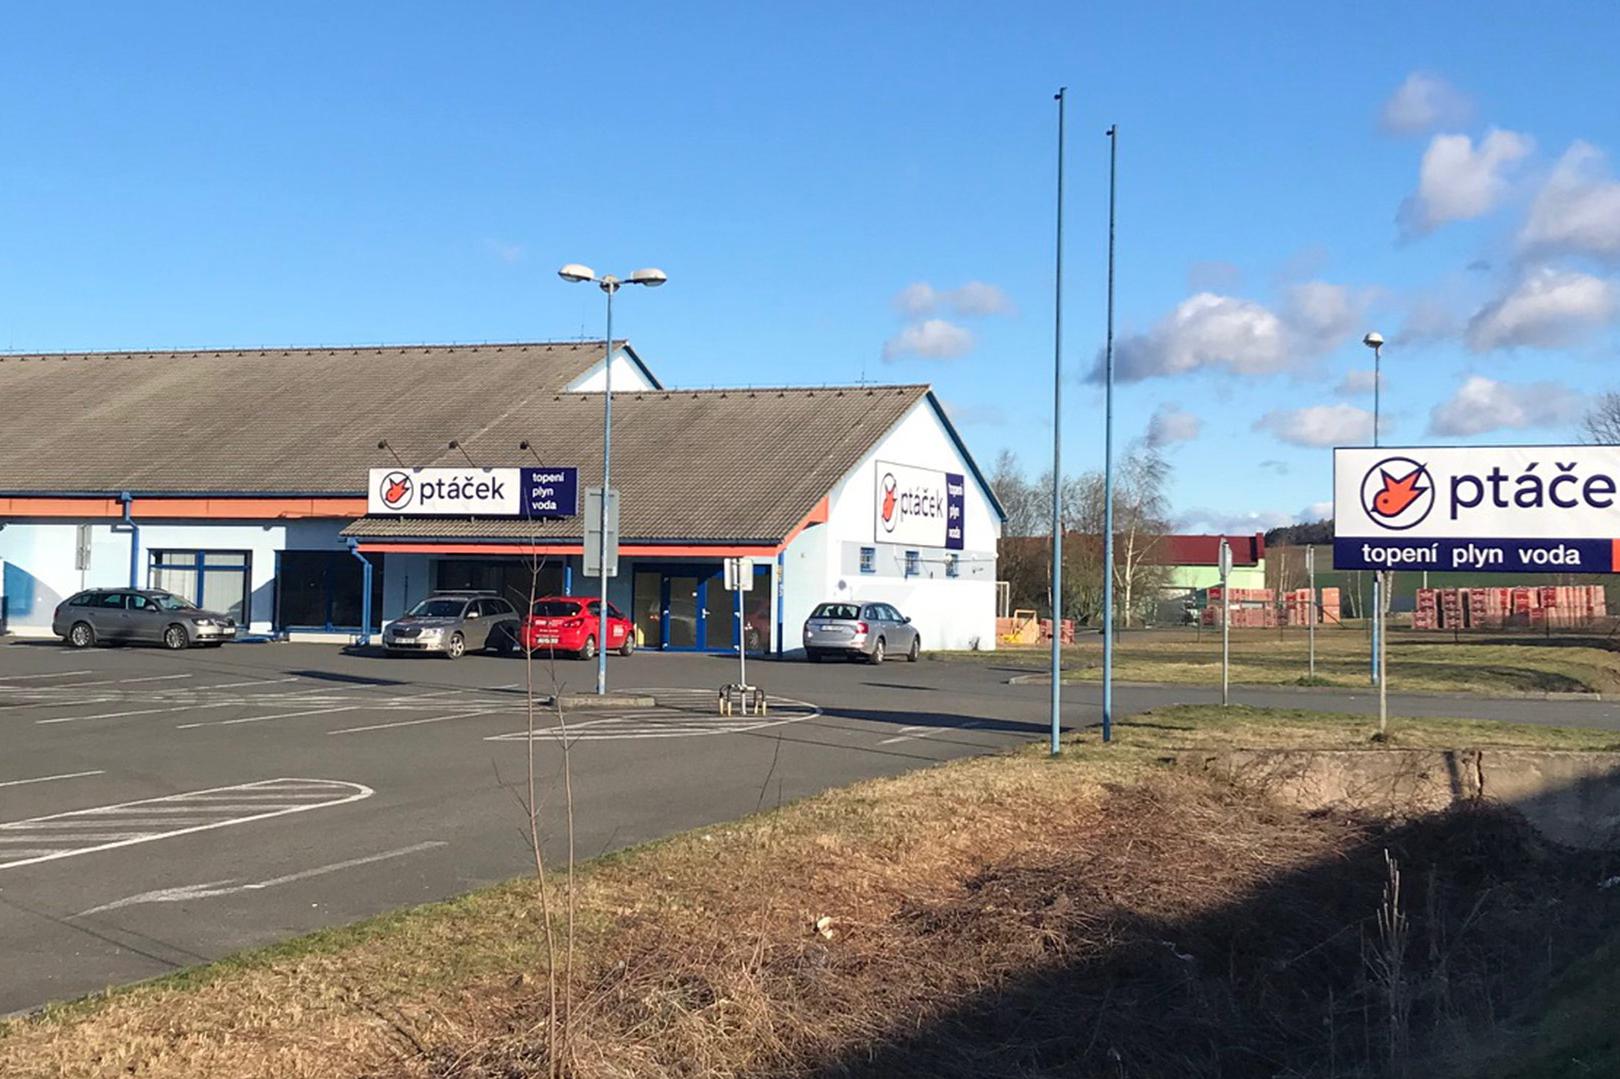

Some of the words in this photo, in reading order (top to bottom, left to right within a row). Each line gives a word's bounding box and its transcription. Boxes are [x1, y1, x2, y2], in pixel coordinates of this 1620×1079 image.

[532, 472, 565, 484] topení
[420, 476, 505, 505] ptáček
[532, 486, 554, 498] plyn
[1450, 462, 1616, 520] ptáče
[532, 500, 557, 510] voda
[900, 486, 944, 523] ptáček
[1362, 543, 1438, 566] topení
[1452, 544, 1504, 567] plyn
[1518, 544, 1581, 565] voda
